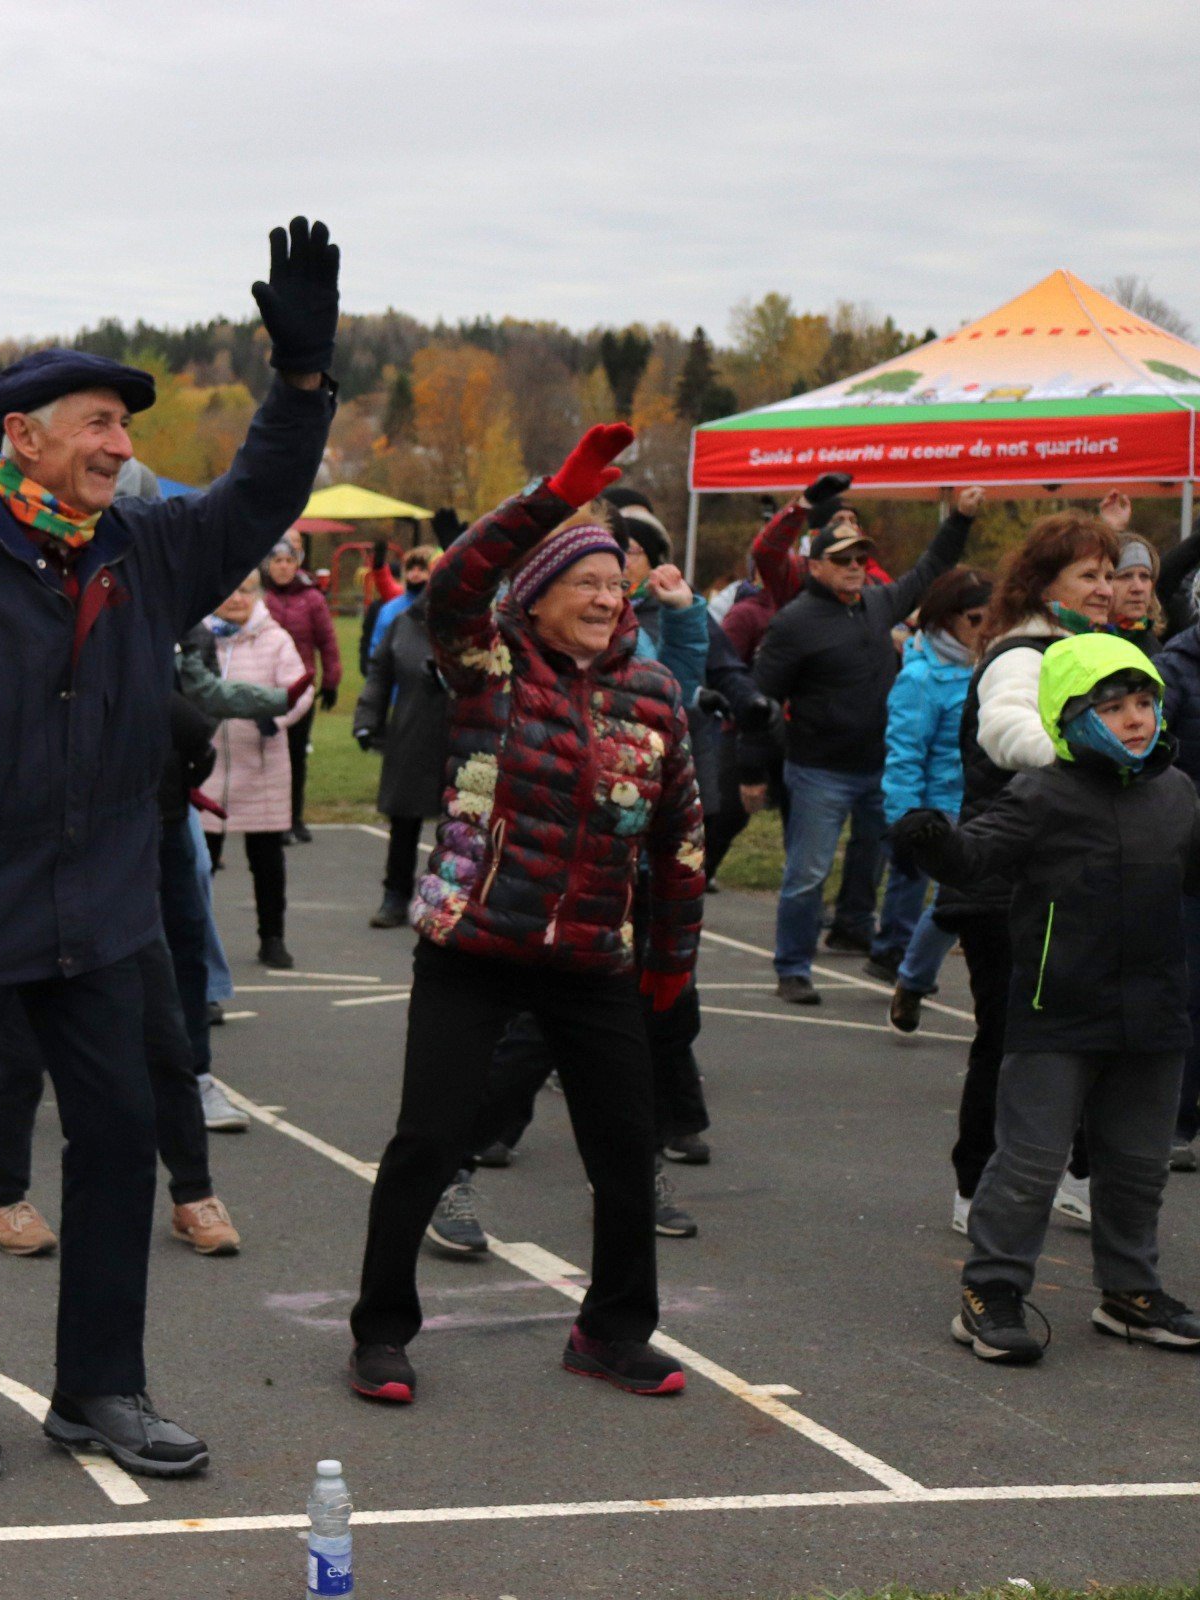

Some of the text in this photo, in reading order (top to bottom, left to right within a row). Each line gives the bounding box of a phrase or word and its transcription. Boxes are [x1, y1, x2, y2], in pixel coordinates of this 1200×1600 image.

[888, 446, 909, 460] au
[912, 443, 964, 459] coeur
[968, 439, 992, 458] de
[997, 440, 1028, 457] nos
[1035, 435, 1119, 459] quartiers
